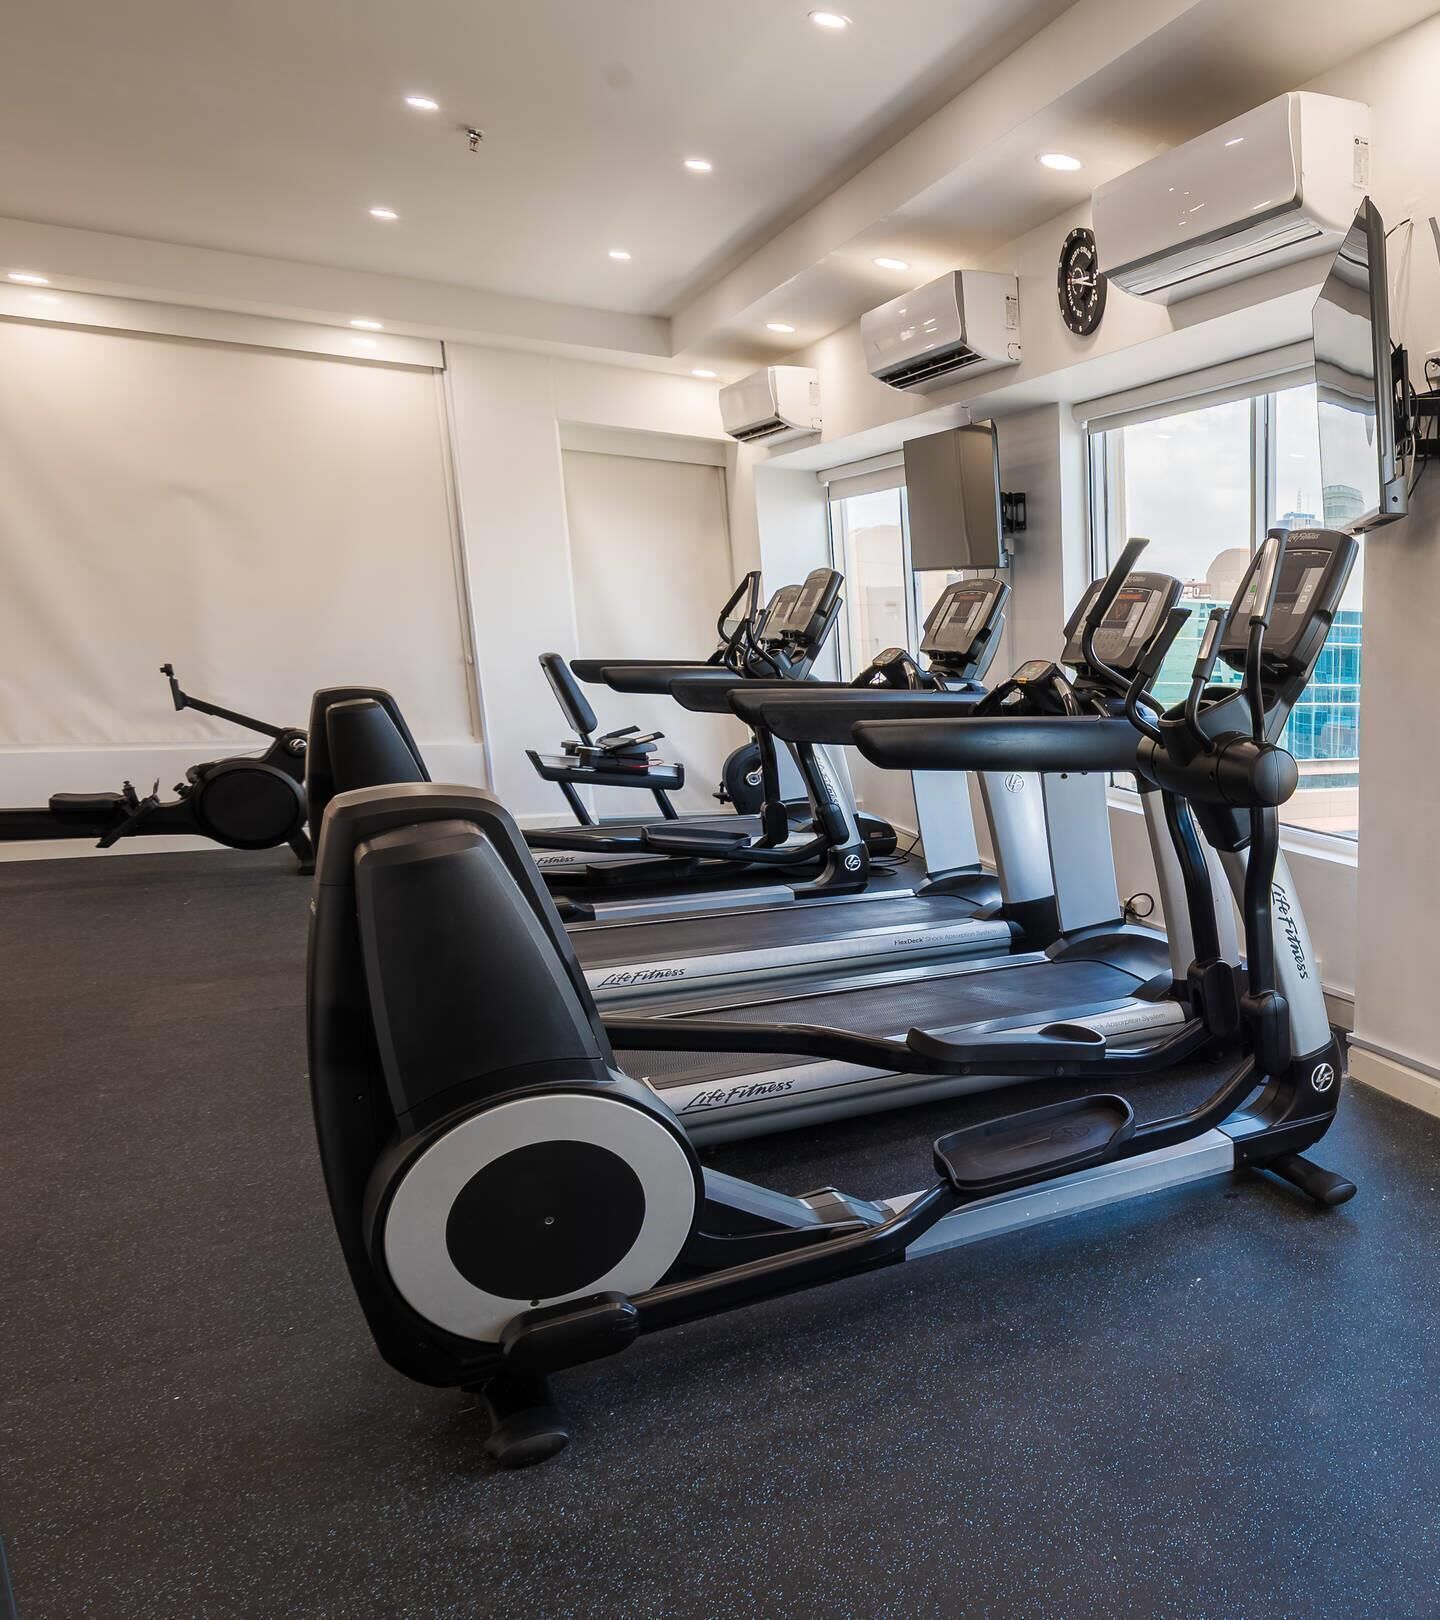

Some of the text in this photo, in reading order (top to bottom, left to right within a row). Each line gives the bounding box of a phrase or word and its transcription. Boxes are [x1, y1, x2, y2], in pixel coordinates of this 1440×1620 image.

[1278, 917, 1310, 979] Fitness
[597, 968, 686, 988] Life Fitness
[682, 1080, 795, 1111] Life Fitness
